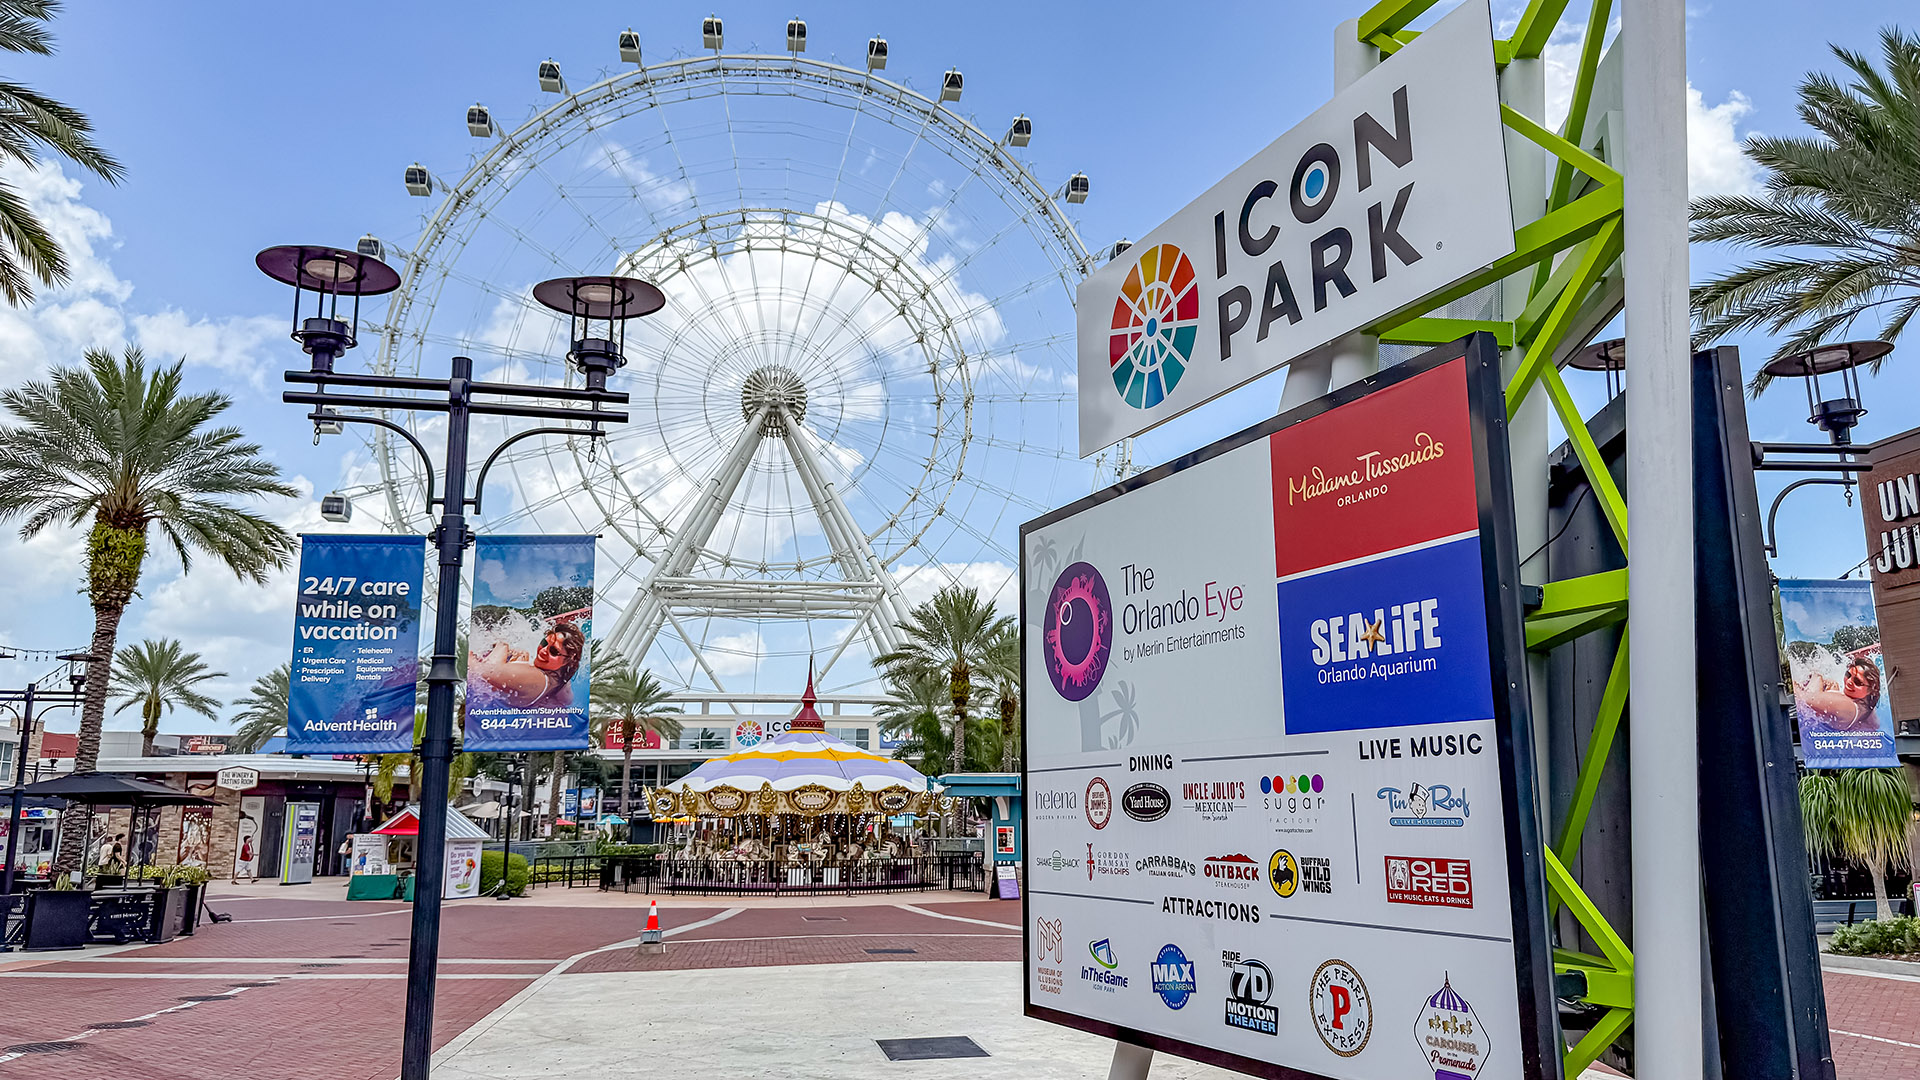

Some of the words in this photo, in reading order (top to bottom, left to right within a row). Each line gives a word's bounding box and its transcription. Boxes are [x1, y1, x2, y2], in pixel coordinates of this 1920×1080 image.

[1214, 84, 1413, 280] ICON
[1217, 181, 1423, 362] PARK
[1288, 466, 1363, 506] Madame
[1356, 432, 1444, 481] Tussauds
[1337, 484, 1388, 507] ORLANDO
[1877, 473, 1920, 522] UN
[303, 576, 357, 596] 24/7
[360, 580, 410, 596] care
[1120, 563, 1155, 596] The
[301, 600, 363, 619] while
[367, 603, 397, 619] on
[1122, 589, 1199, 635] Orlando
[1205, 581, 1243, 622] Eye
[299, 621, 397, 640] vacation
[1310, 612, 1369, 666] SEA
[1123, 647, 1135, 663] by
[1137, 640, 1164, 659] Merlin
[1167, 624, 1245, 653] Entertainments
[302, 657, 328, 666] Urgent
[328, 657, 346, 665] Care
[356, 665, 393, 673] Equipment
[1318, 663, 1366, 685] Orlando
[1369, 656, 1437, 681] Aquarium
[301, 667, 345, 676] Prescription
[301, 675, 331, 684] Delivery
[355, 673, 382, 681] Rentals
[470, 707, 584, 716] AdventHealth.com/StayHealthy
[304, 719, 397, 732] AdventHealth
[480, 717, 572, 730] 844-471-HEAL
[766, 721, 793, 732] ICO
[1358, 738, 1402, 760] LIVE
[1410, 733, 1483, 758] MUSIC
[1814, 739, 1883, 750] 844-471-4325
[1129, 754, 1173, 772] DINING
[1182, 782, 1209, 800] UNCLE
[1210, 781, 1245, 800] JULIO'S
[1035, 790, 1077, 810] helena
[1129, 796, 1144, 809] Yard
[1144, 795, 1165, 809] House
[1195, 801, 1234, 813] MEXICAN
[1263, 796, 1322, 814] sugar
[1377, 786, 1408, 813] Tin
[1427, 784, 1471, 818] Roof
[1036, 857, 1052, 866] SHAKE
[1061, 858, 1080, 868] SHACK
[1097, 851, 1129, 860] GORDON
[1097, 859, 1129, 868] RAMSAY
[1300, 856, 1330, 867] BUFFALO
[1114, 868, 1130, 876] CHIPS
[1135, 855, 1196, 876] CARRABBA'S
[1203, 863, 1260, 881] OUTBACK
[1301, 866, 1331, 881] WILD
[1410, 860, 1468, 878] OLE
[1215, 881, 1248, 889] STEAKHOUSE
[1302, 880, 1332, 894] WINGS
[1412, 876, 1470, 894] RED
[1403, 894, 1424, 902] MUSIC,
[1162, 896, 1260, 924] ATTRACTIONS
[1222, 950, 1241, 962] RIDE
[1222, 960, 1233, 968] THE
[1037, 967, 1056, 976] MUSEUM
[1037, 975, 1063, 986] ILLUSIONS
[1152, 964, 1194, 982] MAX
[1039, 984, 1061, 994] ORLANDO
[1104, 985, 1115, 993] PARK
[1154, 983, 1174, 991] ACTION
[1175, 983, 1194, 991] ARENA
[1234, 963, 1269, 1002] 7D
[1316, 970, 1331, 1000] THE
[1334, 968, 1366, 1008] PEARL
[1227, 1000, 1276, 1022] MOTION
[1330, 984, 1351, 1030] P
[1228, 1013, 1276, 1033] THEATER
[1318, 1013, 1366, 1048] EXPRESS
[1425, 1034, 1479, 1056] CAROUSEL
[1430, 1050, 1476, 1071] Promenade
